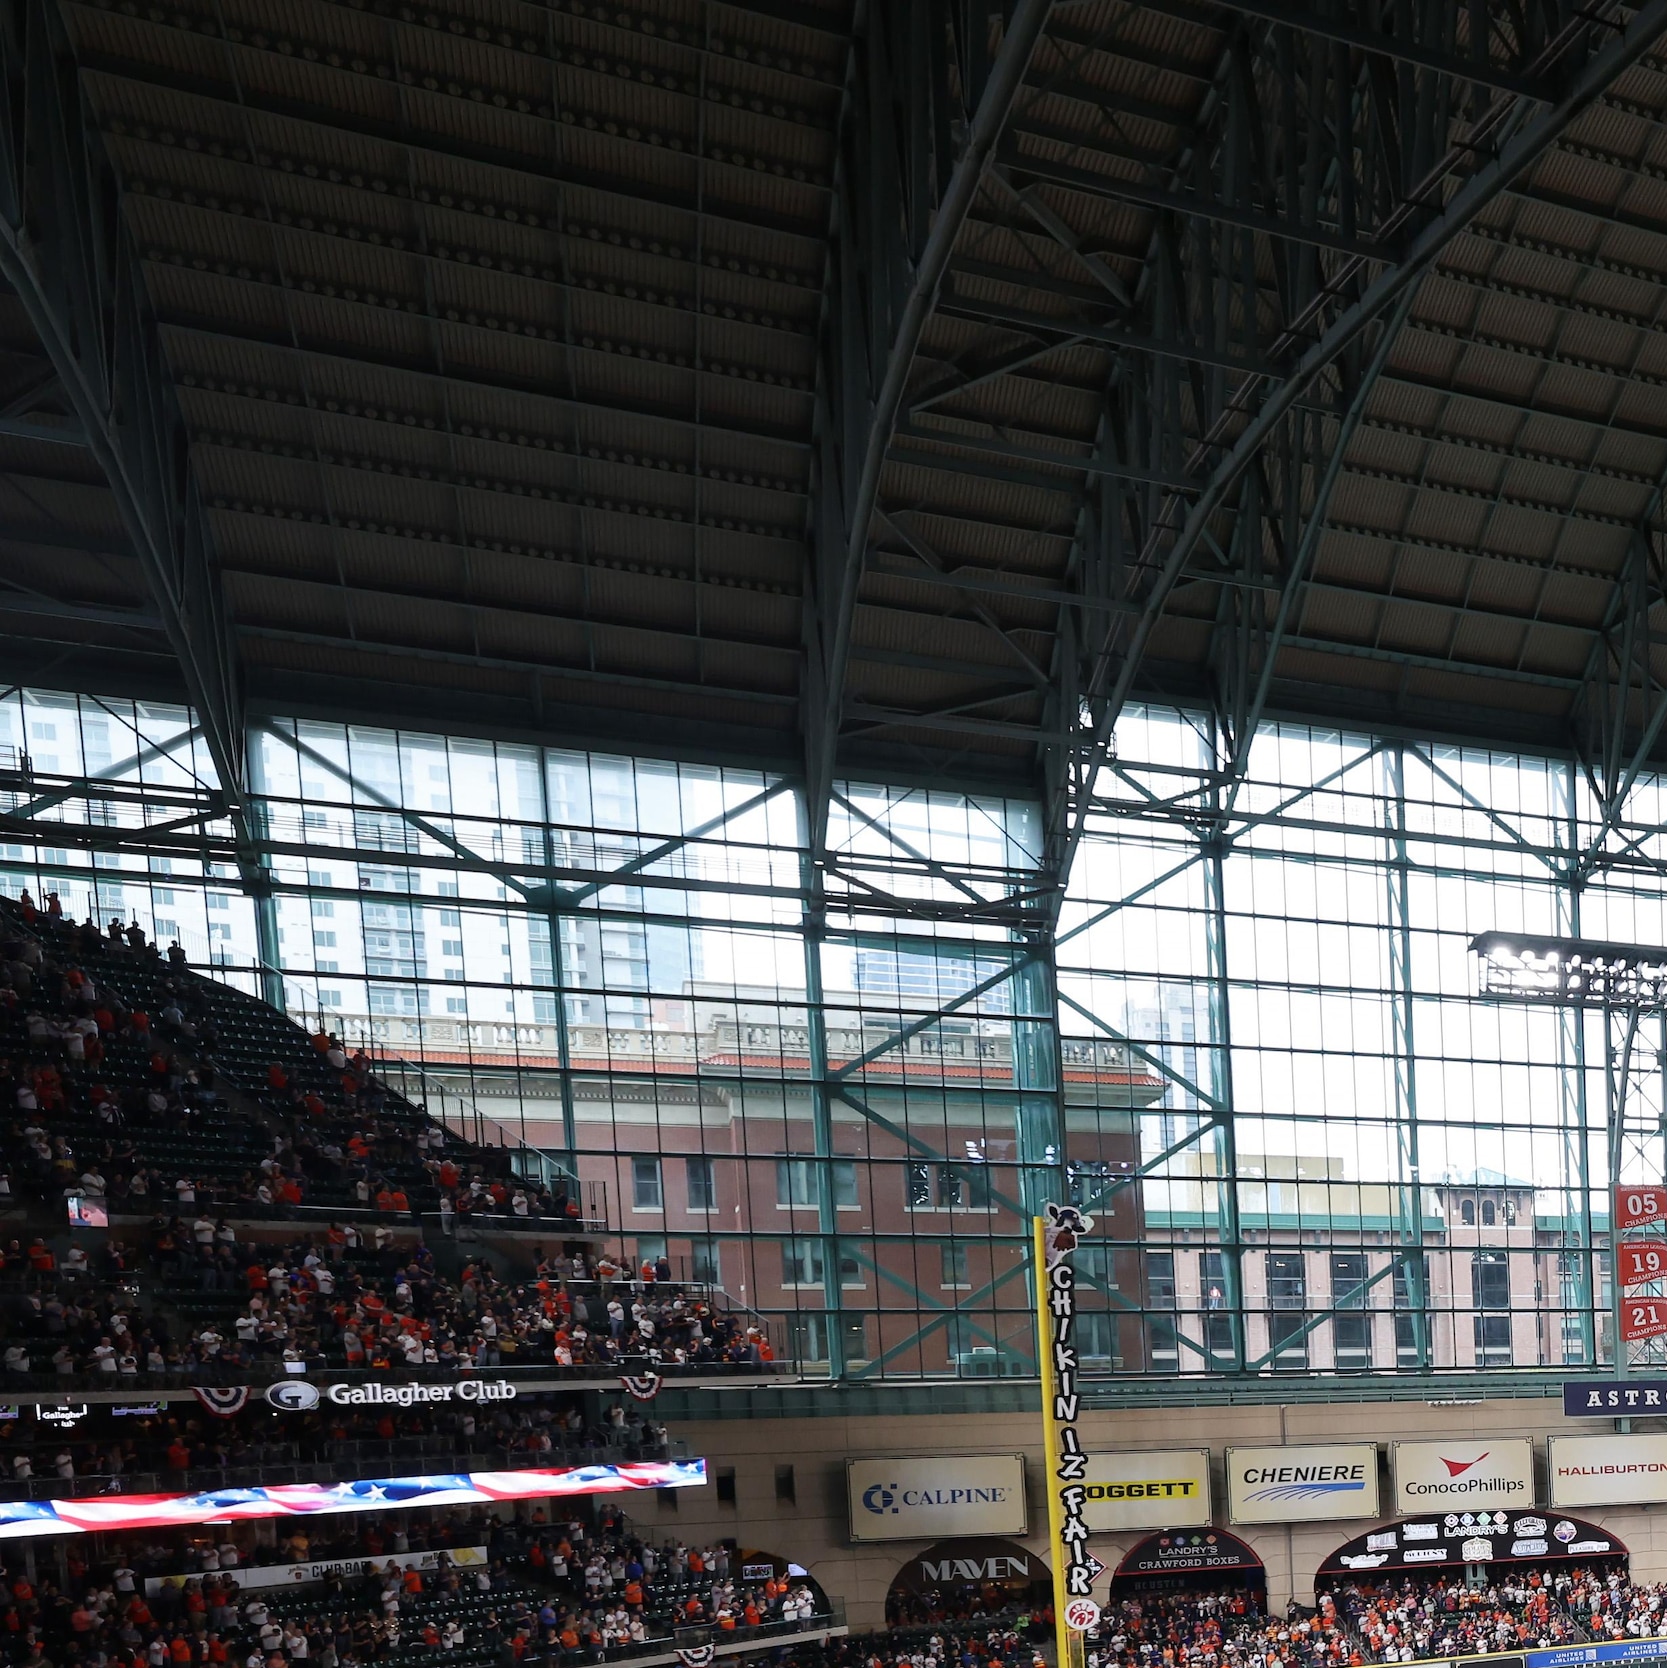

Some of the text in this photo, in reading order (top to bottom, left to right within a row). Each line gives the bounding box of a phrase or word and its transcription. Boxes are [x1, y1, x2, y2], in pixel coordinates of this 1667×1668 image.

[1627, 1193, 1658, 1216] 05
[1624, 1212, 1667, 1228] CHAMPIONS
[1631, 1252, 1660, 1273] 19
[1632, 1305, 1660, 1326] 21
[1627, 1324, 1667, 1339] CHAMPIONS
[327, 1381, 517, 1408] Gallagher Club
[1243, 1465, 1365, 1484] CHENIERE
[1405, 1478, 1525, 1496] ConocoPhillips
[902, 1487, 1006, 1506] CALPINE
[1444, 1524, 1509, 1537] LANDRY'S
[1158, 1545, 1218, 1557] LANDRY'S
[920, 1556, 1029, 1582] MAVEN
[1138, 1556, 1240, 1570] CRAWFORD BOXES
[1556, 1651, 1583, 1660] UNITED
